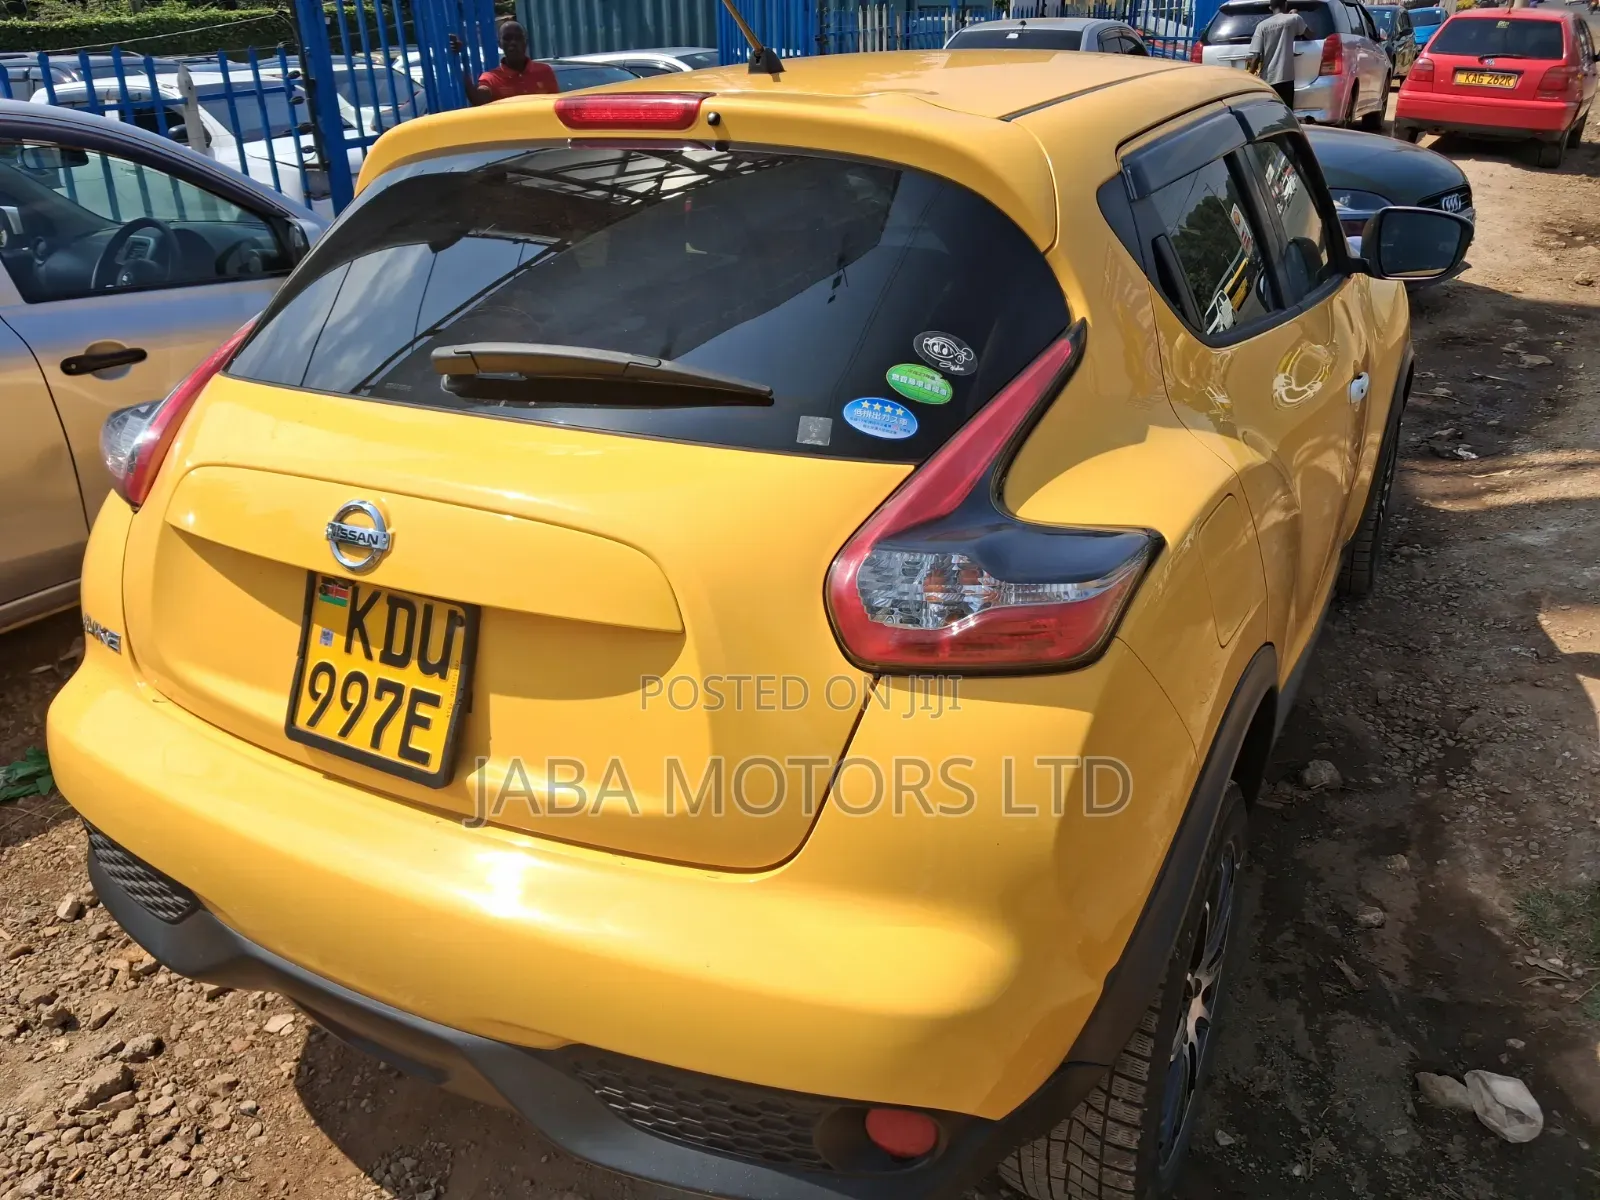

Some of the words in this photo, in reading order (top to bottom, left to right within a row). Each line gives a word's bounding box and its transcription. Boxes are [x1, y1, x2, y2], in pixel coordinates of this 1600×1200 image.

[1465, 72, 1485, 84] KAG
[1487, 74, 1512, 86] 262R
[332, 524, 379, 546] NISSAN
[344, 583, 457, 681] KDU
[306, 661, 442, 767] 997E
